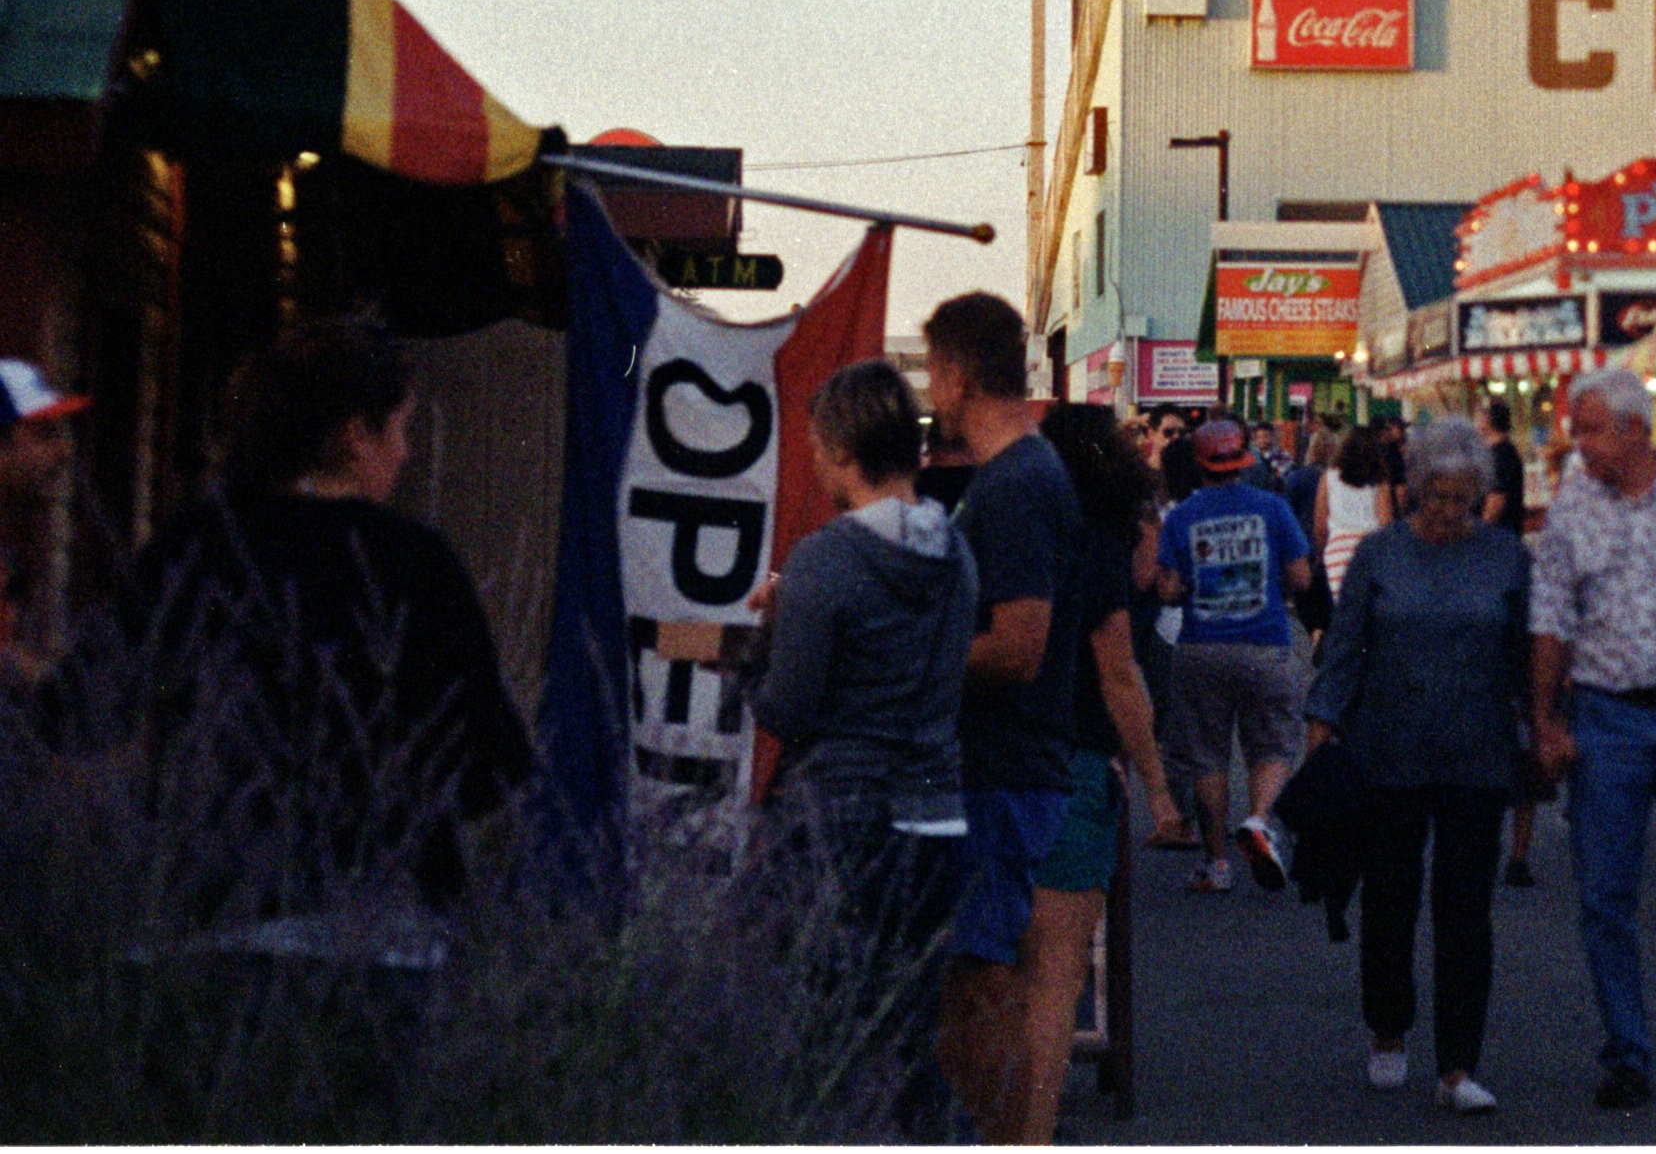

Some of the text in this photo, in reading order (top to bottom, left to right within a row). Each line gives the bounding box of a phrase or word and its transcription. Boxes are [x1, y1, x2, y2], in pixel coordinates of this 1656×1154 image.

[1287, 7, 1402, 49] Coca-Cola
[682, 255, 757, 285] ATM
[1249, 266, 1323, 297] Jay's
[1217, 297, 1267, 322] FAMOUS
